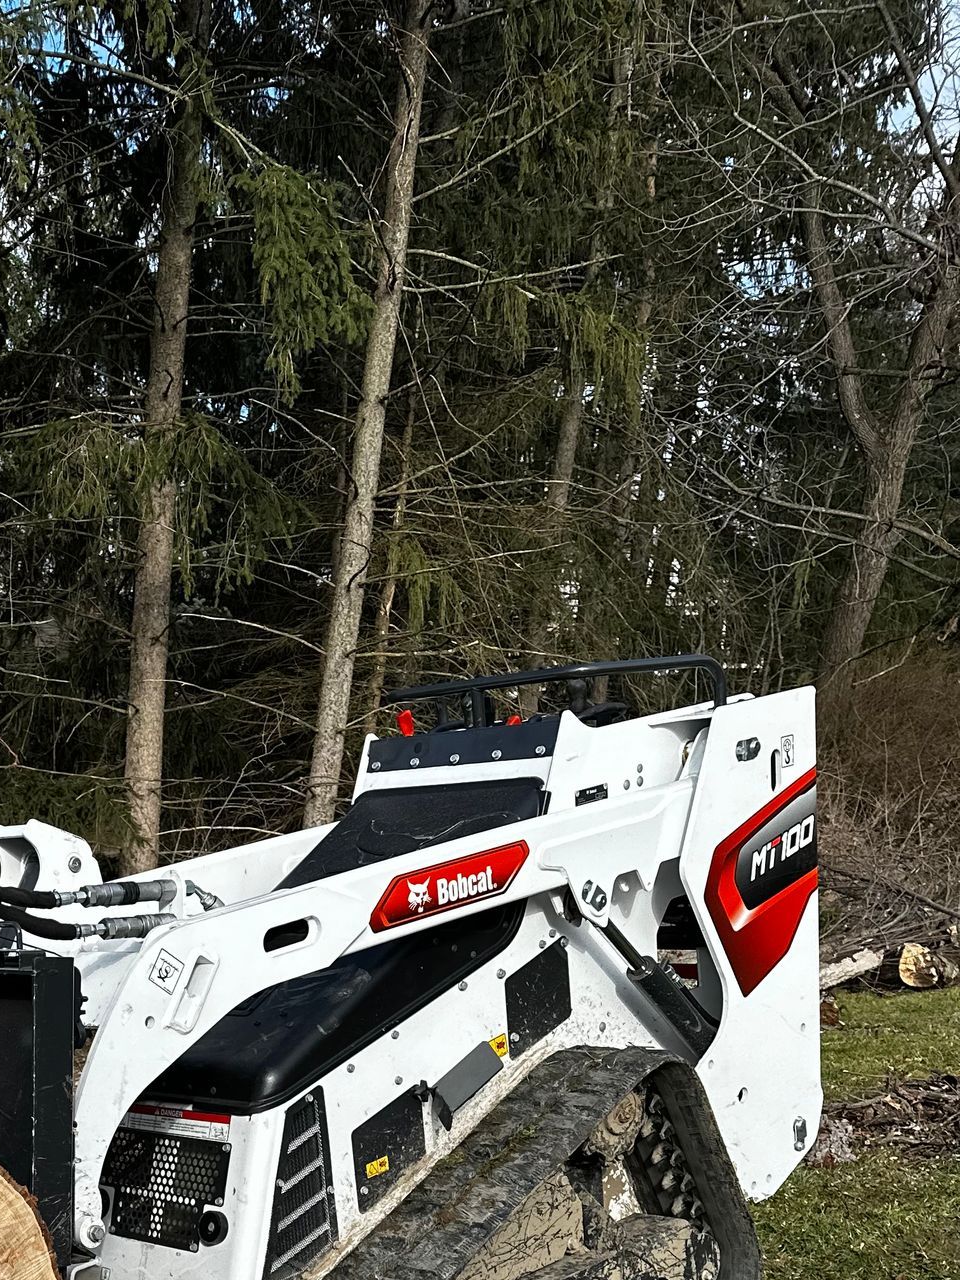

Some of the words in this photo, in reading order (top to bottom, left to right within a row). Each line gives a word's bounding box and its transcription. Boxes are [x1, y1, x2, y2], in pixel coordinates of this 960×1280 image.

[750, 814, 815, 882] MT100
[436, 866, 497, 906] Bobcat
[160, 1108, 183, 1118] DANGER
